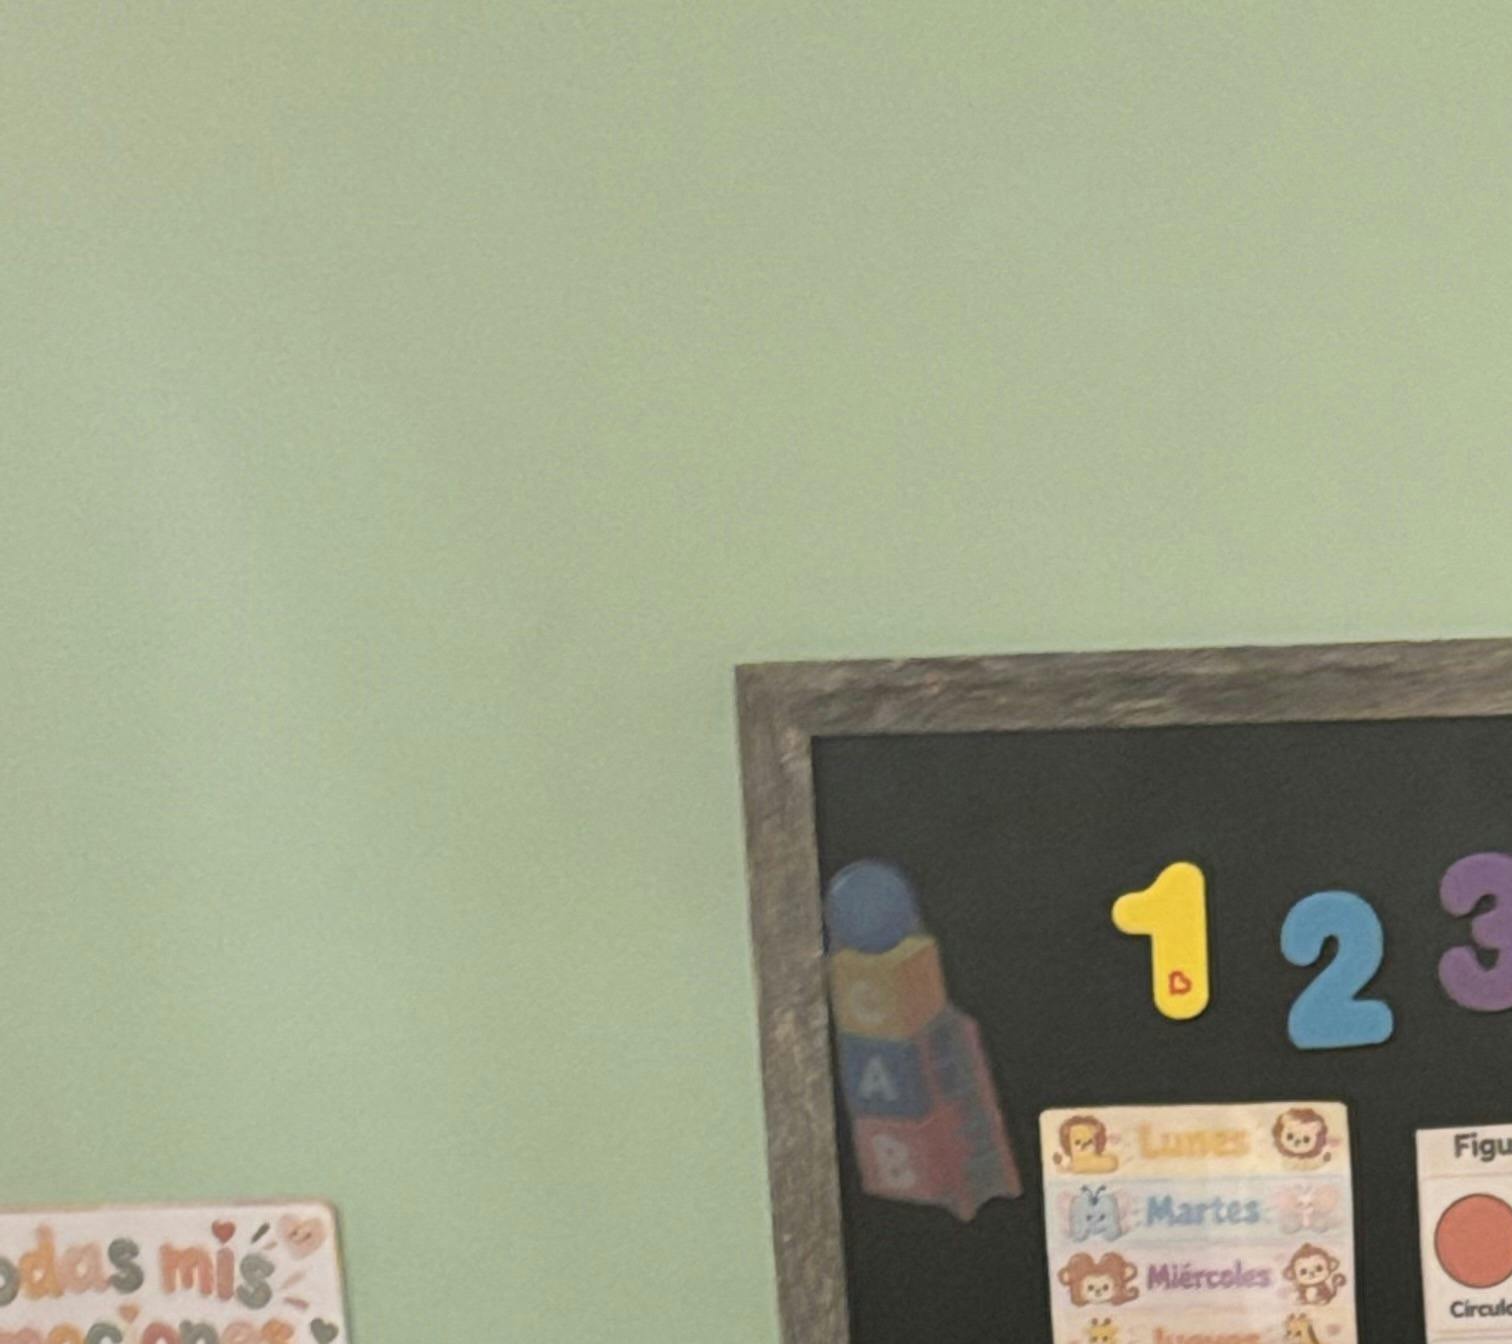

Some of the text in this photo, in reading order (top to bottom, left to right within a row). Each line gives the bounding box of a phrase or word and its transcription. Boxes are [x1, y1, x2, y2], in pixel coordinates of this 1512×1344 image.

[1111, 861, 1209, 1020] 1
[1280, 889, 1394, 1050] 2
[1138, 1121, 1252, 1160] Lunes
[1146, 1193, 1261, 1226] Martes
[159, 1219, 275, 1309] mis
[1146, 1260, 1273, 1291] Miércoles
